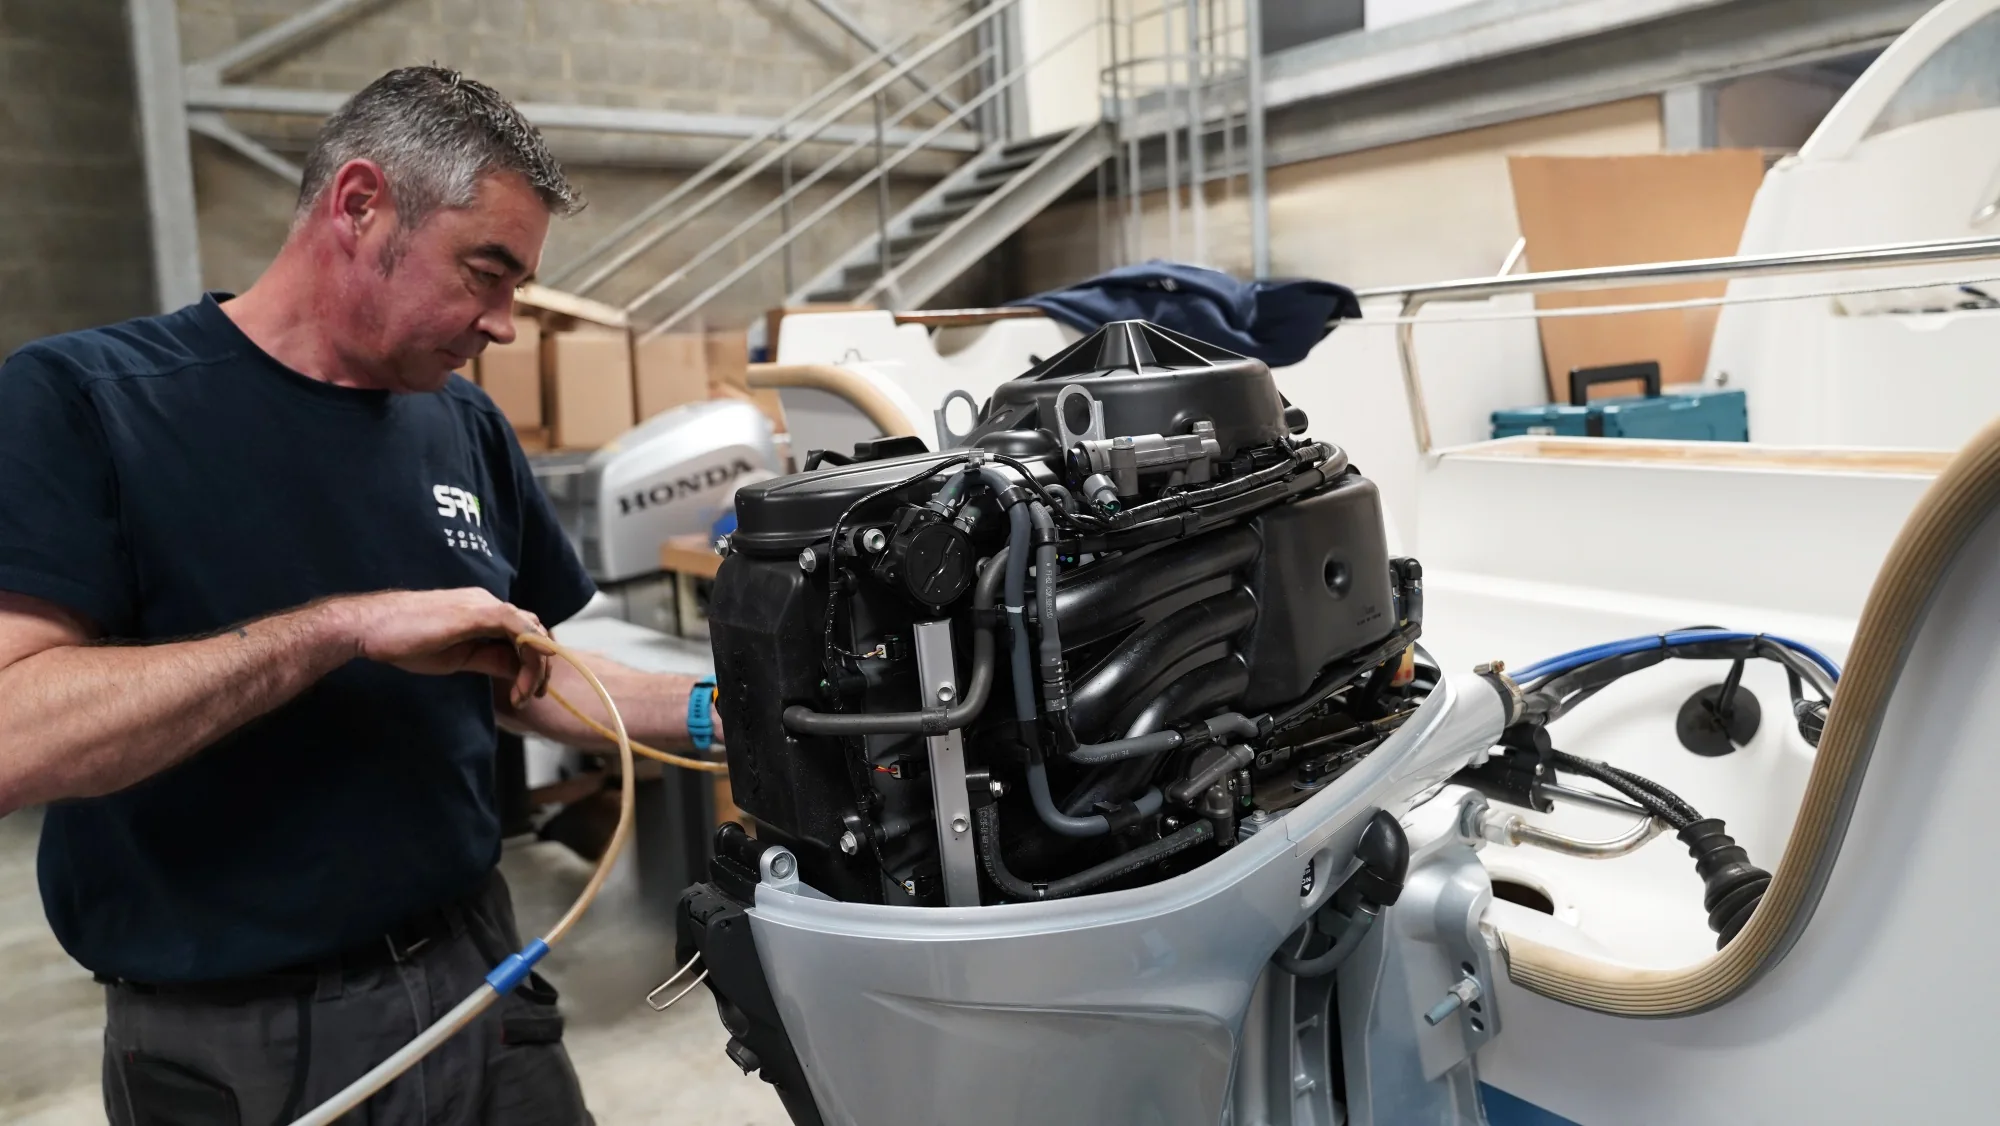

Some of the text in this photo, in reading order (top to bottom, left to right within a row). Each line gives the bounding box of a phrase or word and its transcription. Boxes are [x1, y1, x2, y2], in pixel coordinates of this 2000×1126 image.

[619, 458, 752, 516] HONDA
[444, 528, 488, 547] VOLVO
[447, 538, 493, 557] PENTA
